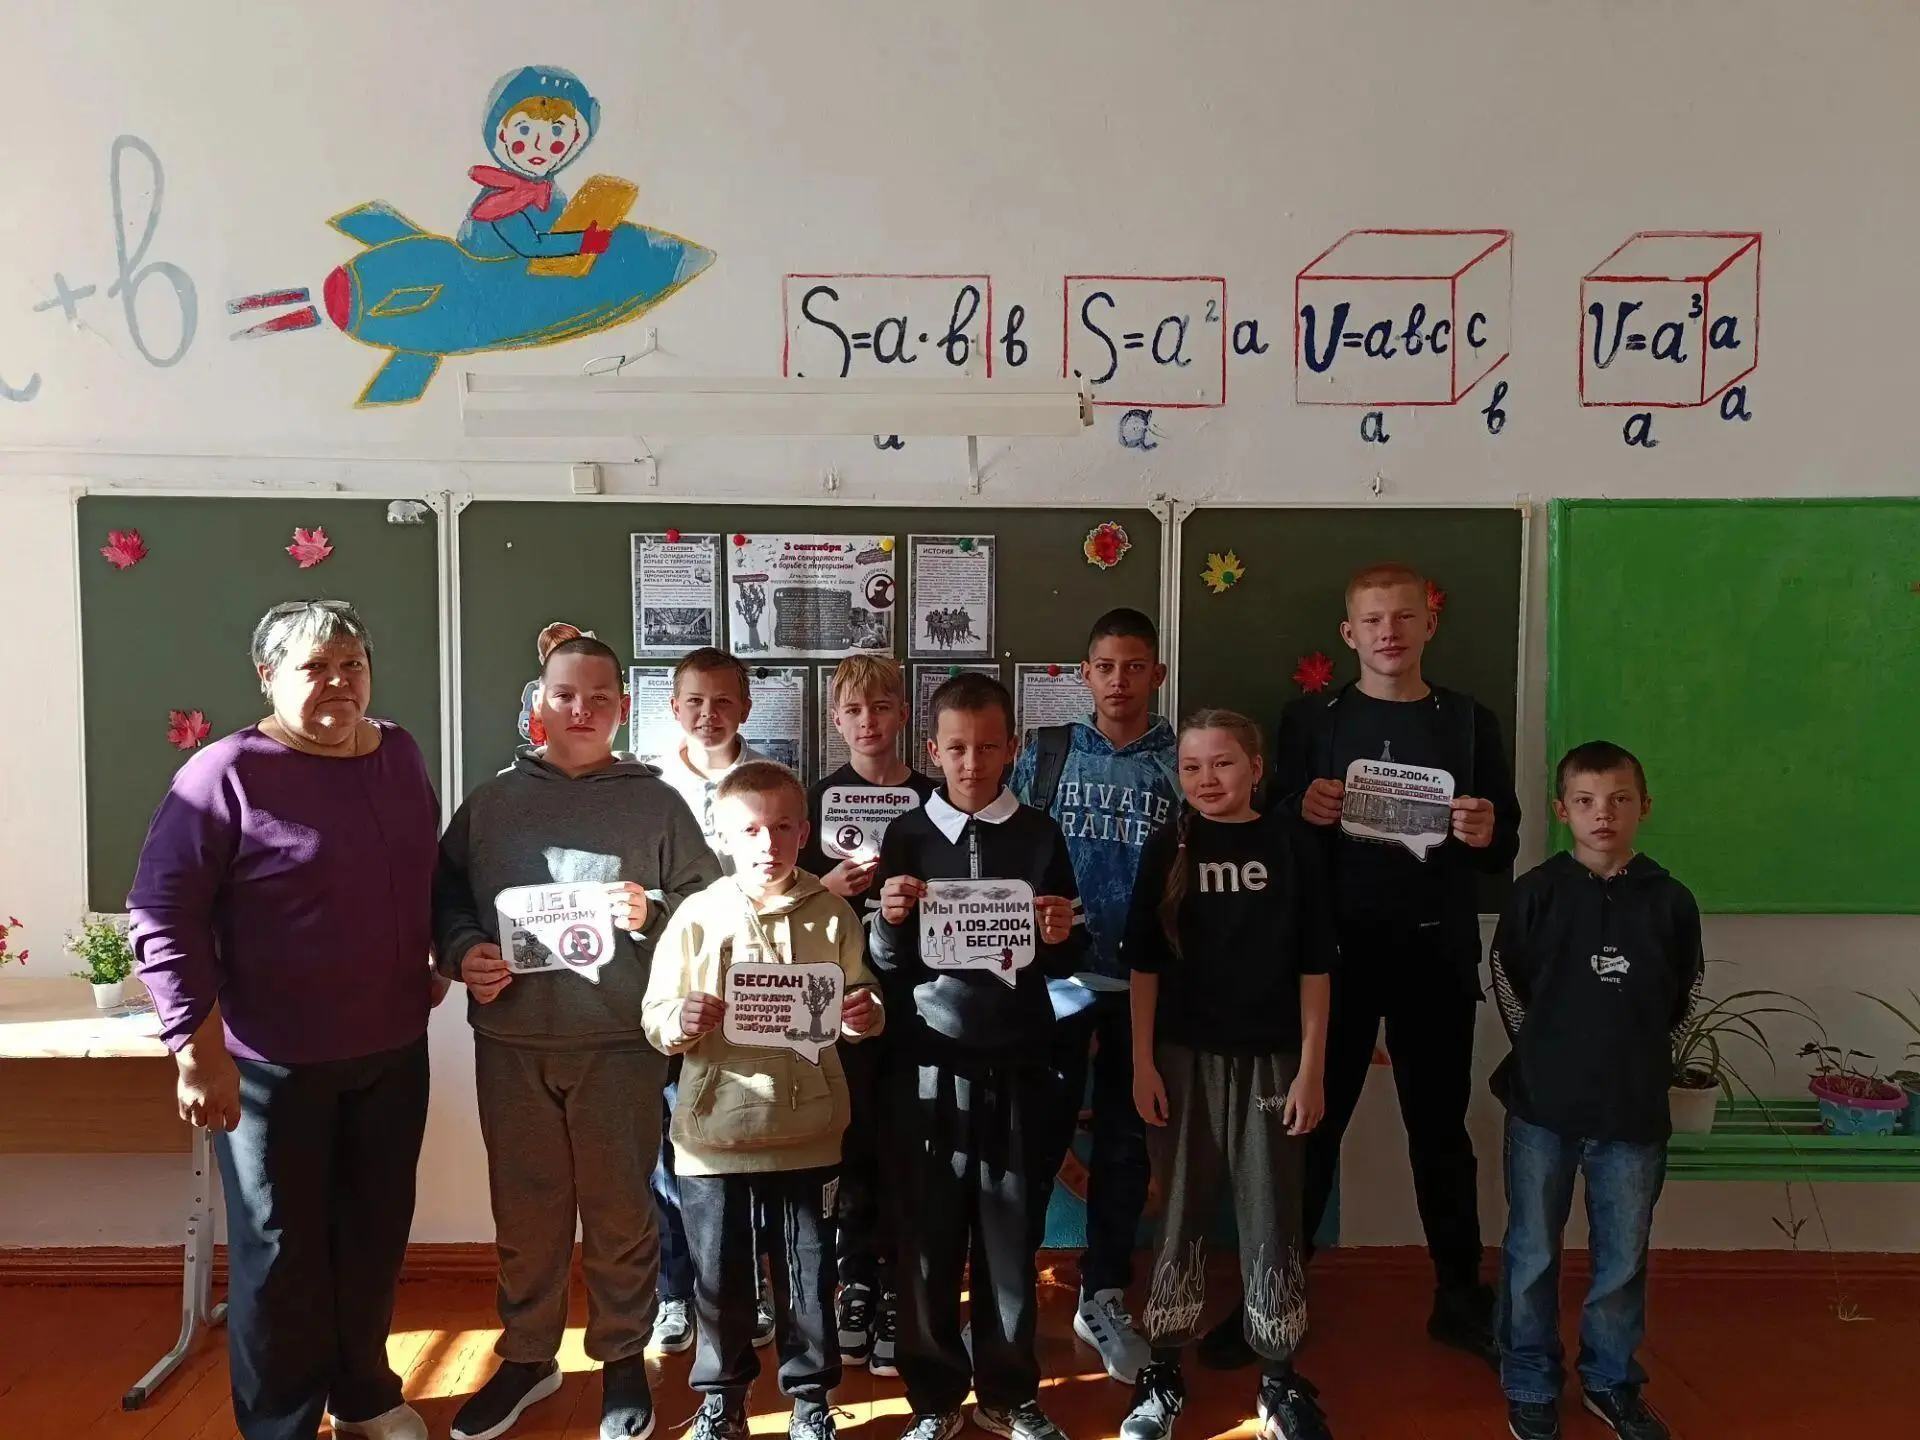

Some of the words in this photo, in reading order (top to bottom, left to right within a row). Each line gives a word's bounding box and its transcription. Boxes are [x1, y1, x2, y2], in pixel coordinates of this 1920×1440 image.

[784, 541, 791, 551] 3
[793, 542, 842, 552] сентября
[779, 553, 796, 561] День
[797, 554, 844, 564] солидарности
[778, 562, 801, 570] борьбе
[1362, 765, 1429, 782] 1-3.09.2004
[832, 792, 841, 803] 3
[845, 793, 910, 806] сентября
[1199, 860, 1268, 893] me
[923, 901, 953, 915] Мы
[510, 910, 598, 928] ТЕРРОРИЗМУ
[955, 919, 1031, 932] 1.09.2004
[966, 935, 1031, 948] БЕСЛАН
[1603, 945, 1618, 953] OFF
[733, 973, 803, 988] БЕСЛАН
[1600, 976, 1622, 984] WHITE
[732, 991, 796, 1003] Трагедия,
[735, 1004, 792, 1014] которую
[734, 1013, 772, 1023] никто
[776, 1014, 792, 1023] не
